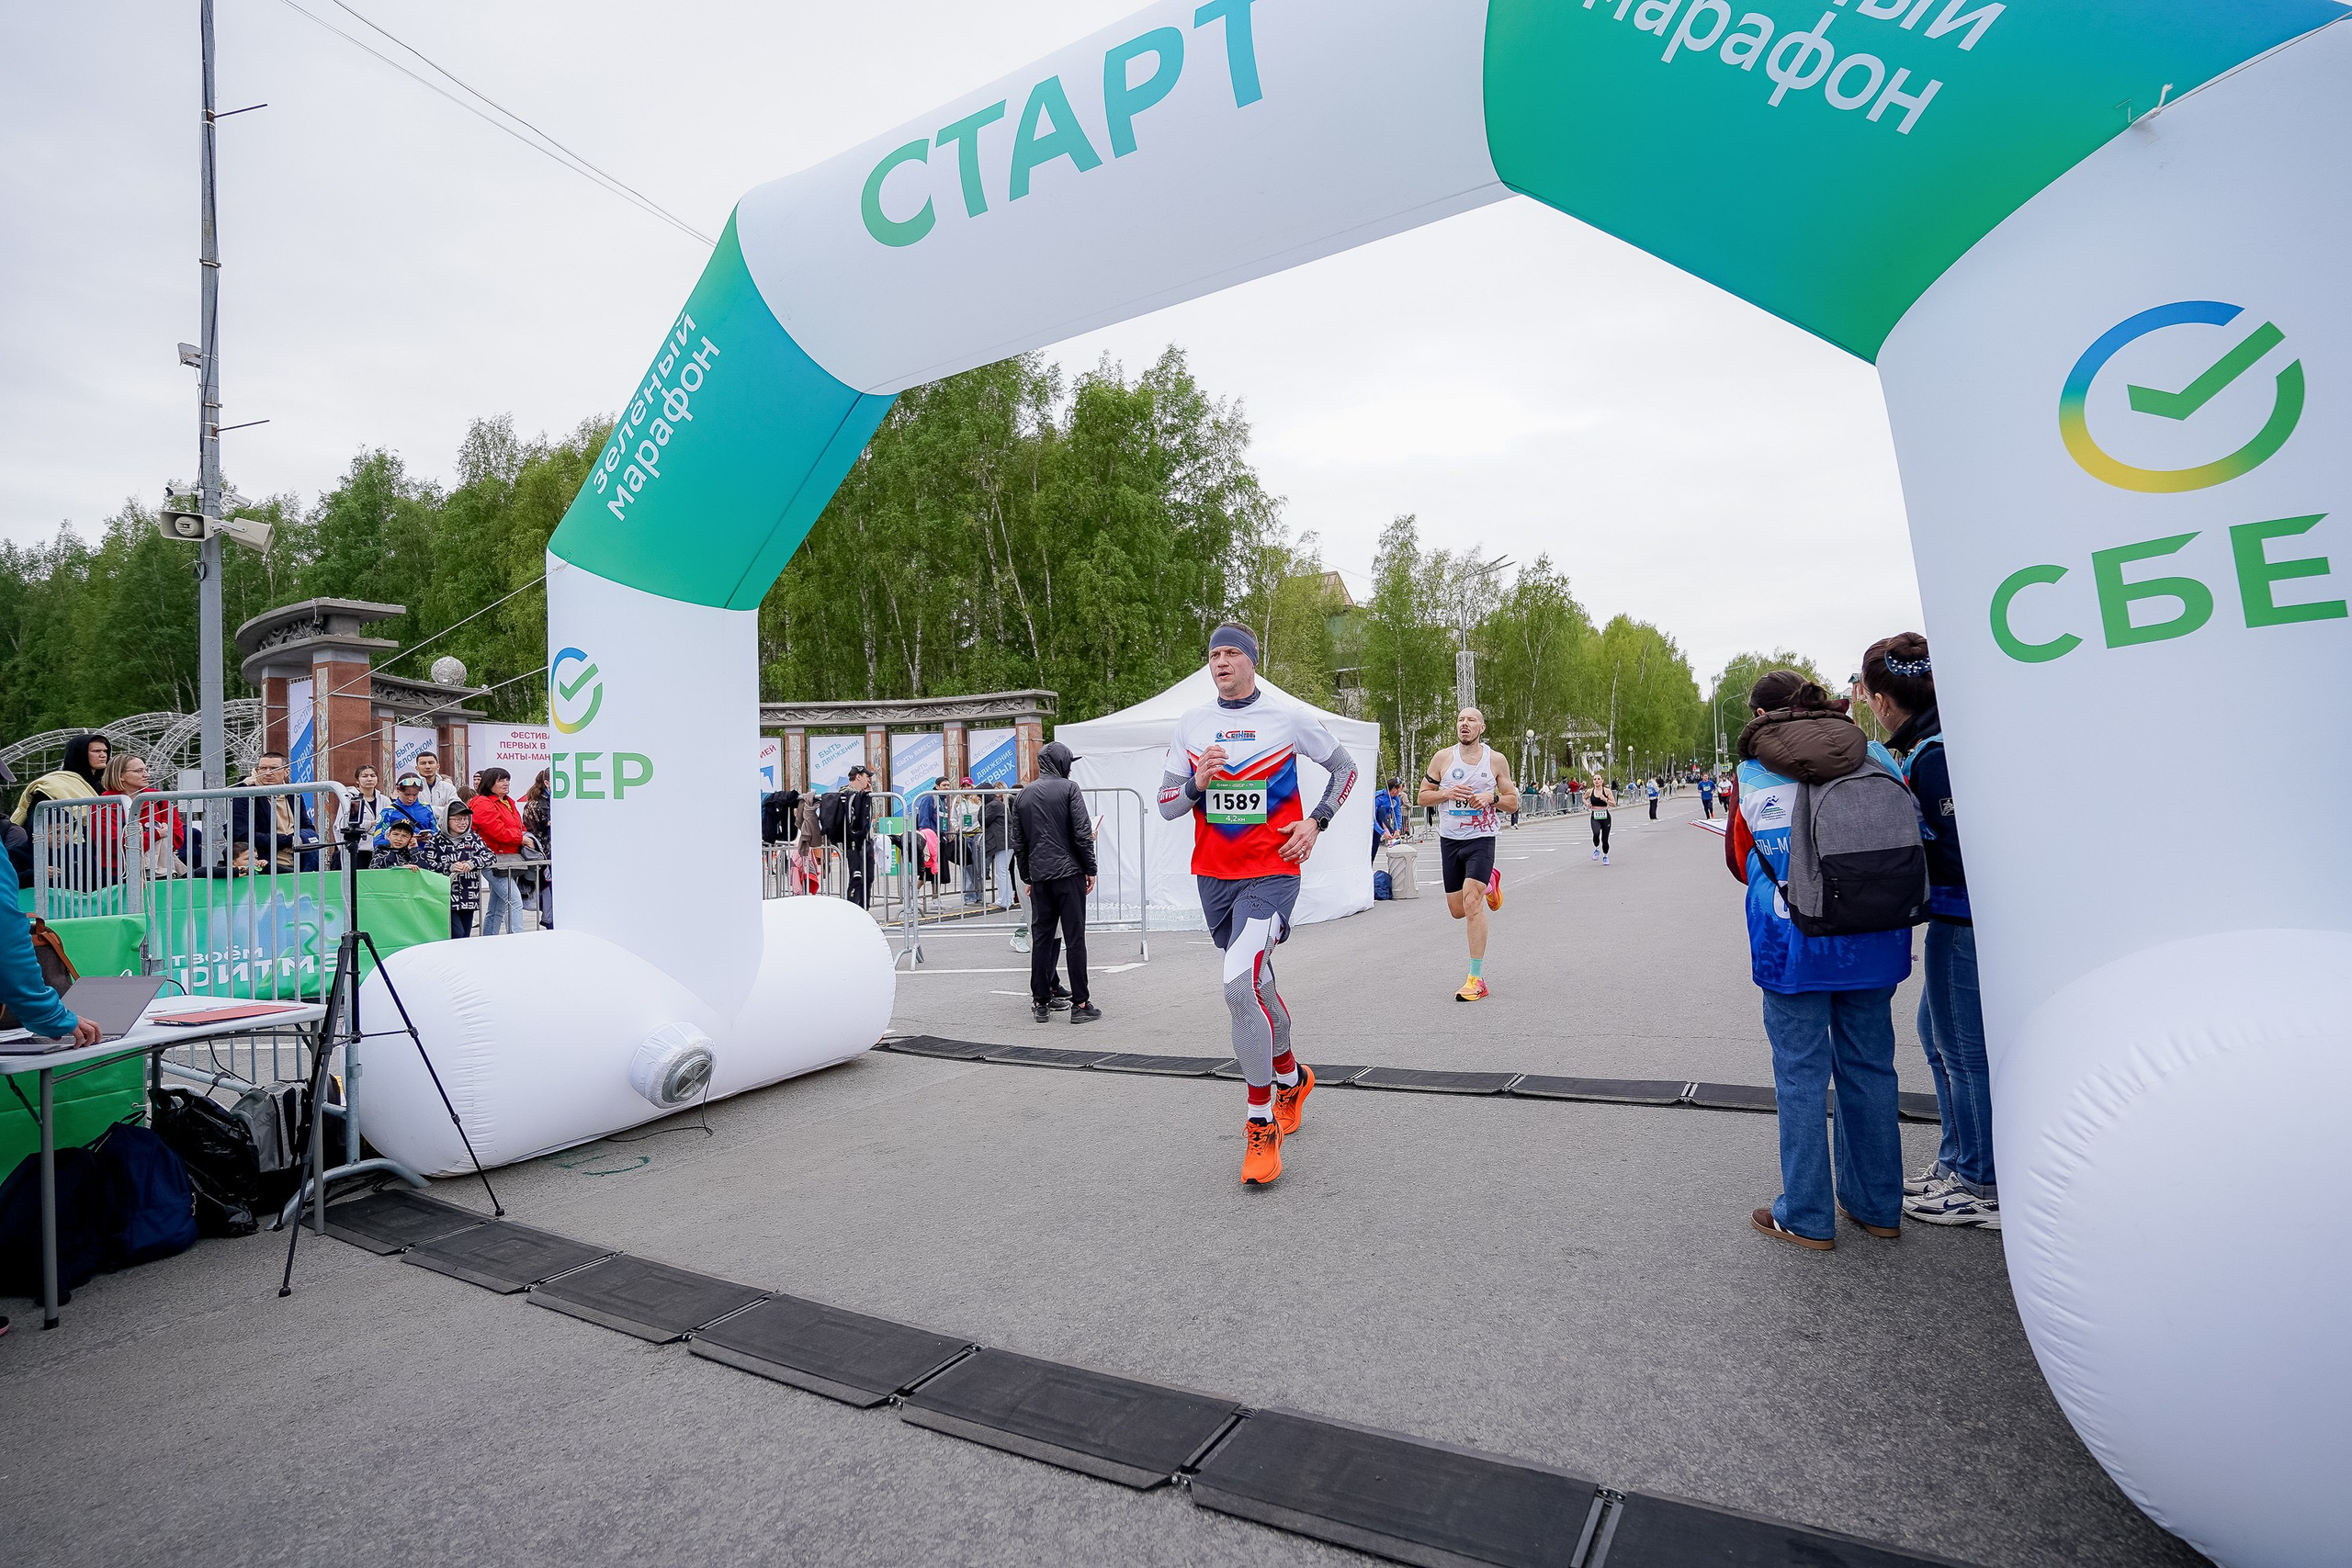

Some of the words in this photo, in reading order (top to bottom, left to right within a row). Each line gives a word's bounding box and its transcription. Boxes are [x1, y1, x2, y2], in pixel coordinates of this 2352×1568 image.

[1582, 0, 1944, 136] арафон
[861, 0, 1264, 248] СТАРТ
[593, 310, 697, 495] зелёный
[606, 335, 721, 522] марафон
[1989, 512, 2349, 663] СБЕ
[396, 740, 415, 759] БЫТЬ
[499, 740, 538, 750] ПЕРВЫХ
[538, 741, 547, 750] В
[817, 742, 842, 759] БЫТЬ
[821, 739, 861, 766] ДВИЖЕНИИ
[896, 753, 914, 768] БЫТЬ
[914, 738, 941, 757] ВМЕСТЕ
[910, 761, 929, 775] БЫТЬ
[976, 749, 1014, 781] ДВИЖЕНИЕ
[1212, 793, 1261, 810] 1589
[1455, 800, 1476, 808] 89
